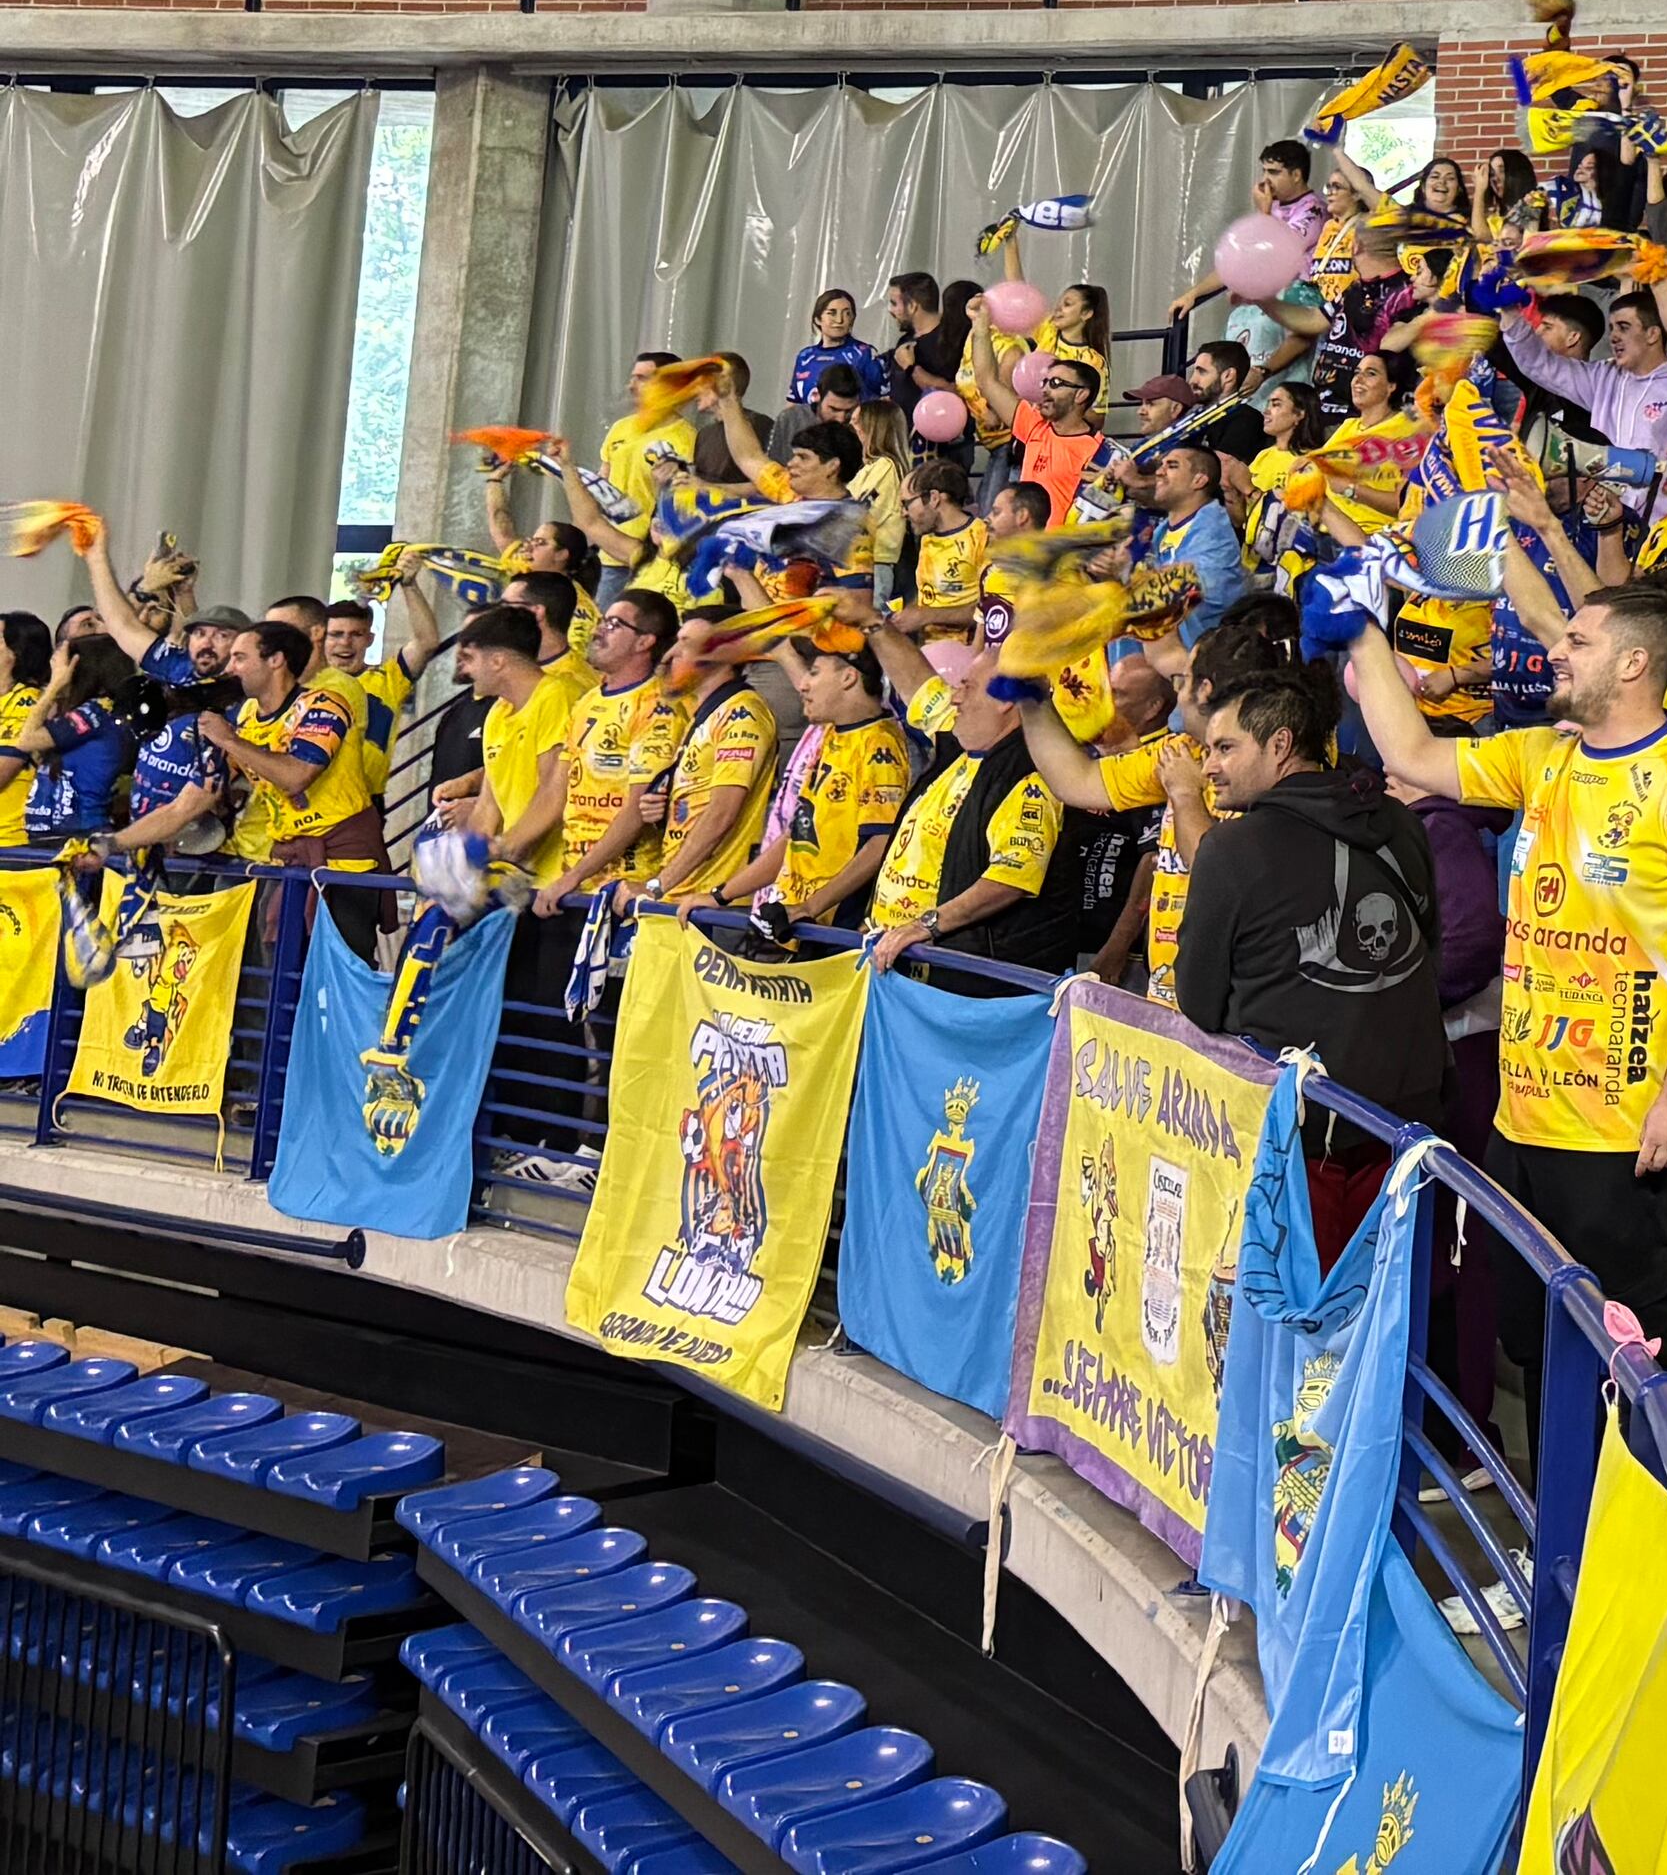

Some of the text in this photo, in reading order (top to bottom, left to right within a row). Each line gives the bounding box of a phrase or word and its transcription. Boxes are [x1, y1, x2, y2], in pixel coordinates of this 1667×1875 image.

[1534, 928, 1626, 955] aranda
[1559, 991, 1603, 1003] TUDANCA
[1535, 1014, 1595, 1051] JJG
[1604, 971, 1630, 1105] tecnoaranda
[1627, 971, 1658, 1085] haizea
[1554, 1070, 1598, 1087] LEÓN
[1075, 1039, 1242, 1168] SALVE ARANDA
